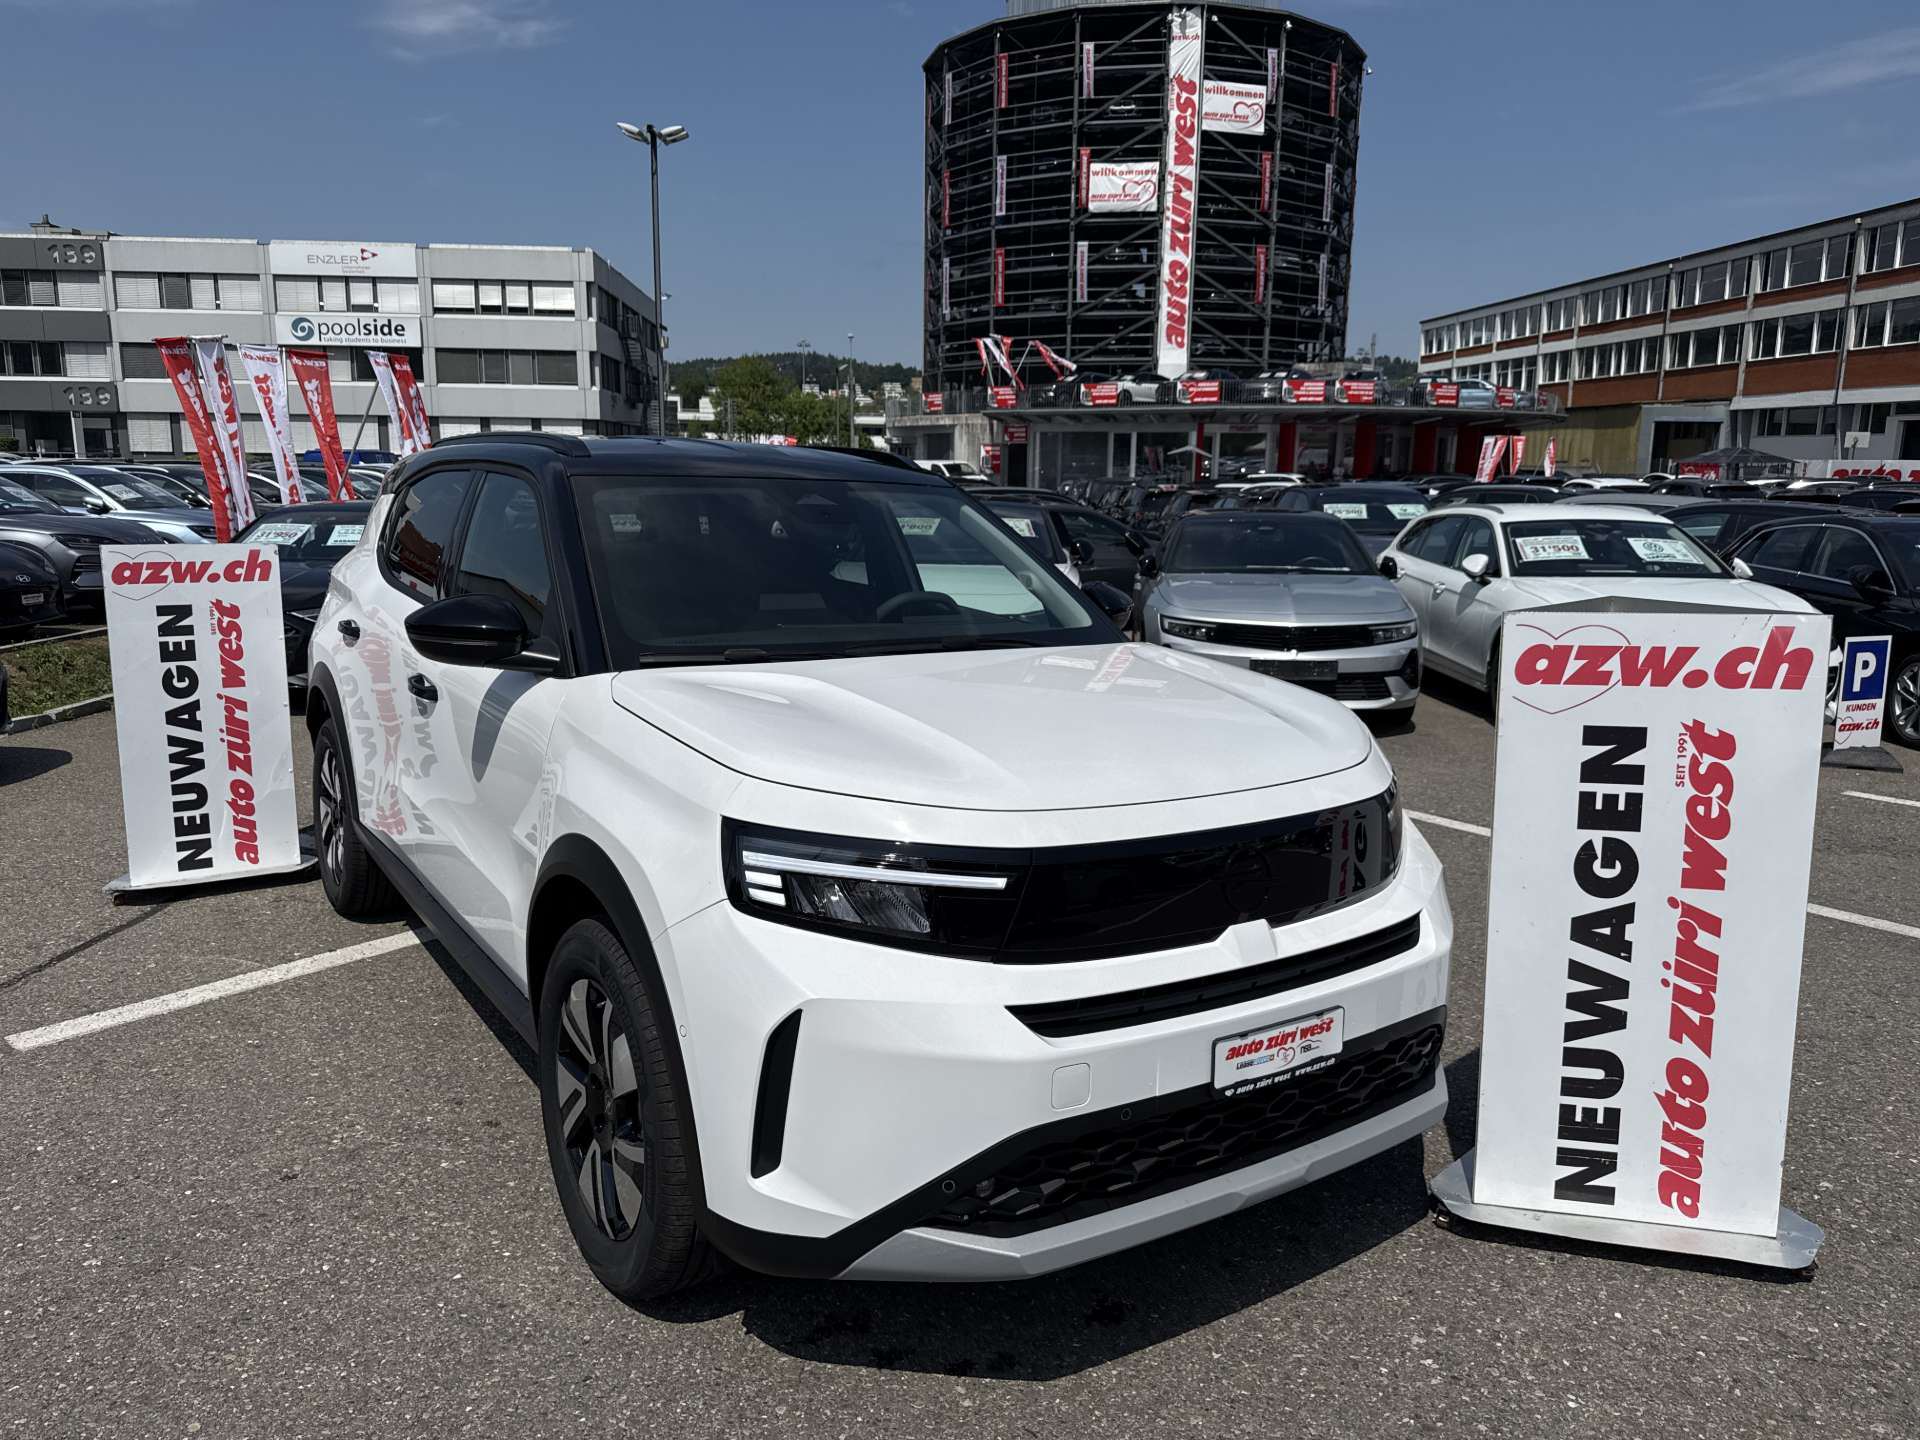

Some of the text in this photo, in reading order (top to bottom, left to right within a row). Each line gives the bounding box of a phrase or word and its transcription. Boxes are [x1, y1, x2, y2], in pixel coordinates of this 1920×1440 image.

[1204, 85, 1265, 99] willkommen
[1091, 167, 1157, 177] willkommen
[1164, 73, 1198, 350] auto züri west
[307, 254, 359, 265] ENZLER
[318, 318, 406, 342] poolside
[323, 336, 343, 344] taking
[257, 530, 299, 538] 31'950
[1530, 544, 1580, 553] 31'500
[111, 549, 273, 586] azw.ch
[1514, 626, 1815, 690] azw.ch
[1852, 651, 1877, 693] P
[1845, 702, 1877, 713] KUNDEN
[156, 604, 214, 873] NEUWAGEN
[209, 598, 260, 866] auto züri west
[1838, 718, 1880, 732] azw.ch
[1675, 732, 1688, 788] SEIT 1991
[1553, 725, 1648, 1205] NEUWAGEN
[1653, 718, 1737, 1220] auto züri west
[1225, 1017, 1335, 1061] auto züri west
[1236, 1084, 1254, 1095] auto
[1256, 1077, 1273, 1088] züri
[1274, 1072, 1292, 1083] west
